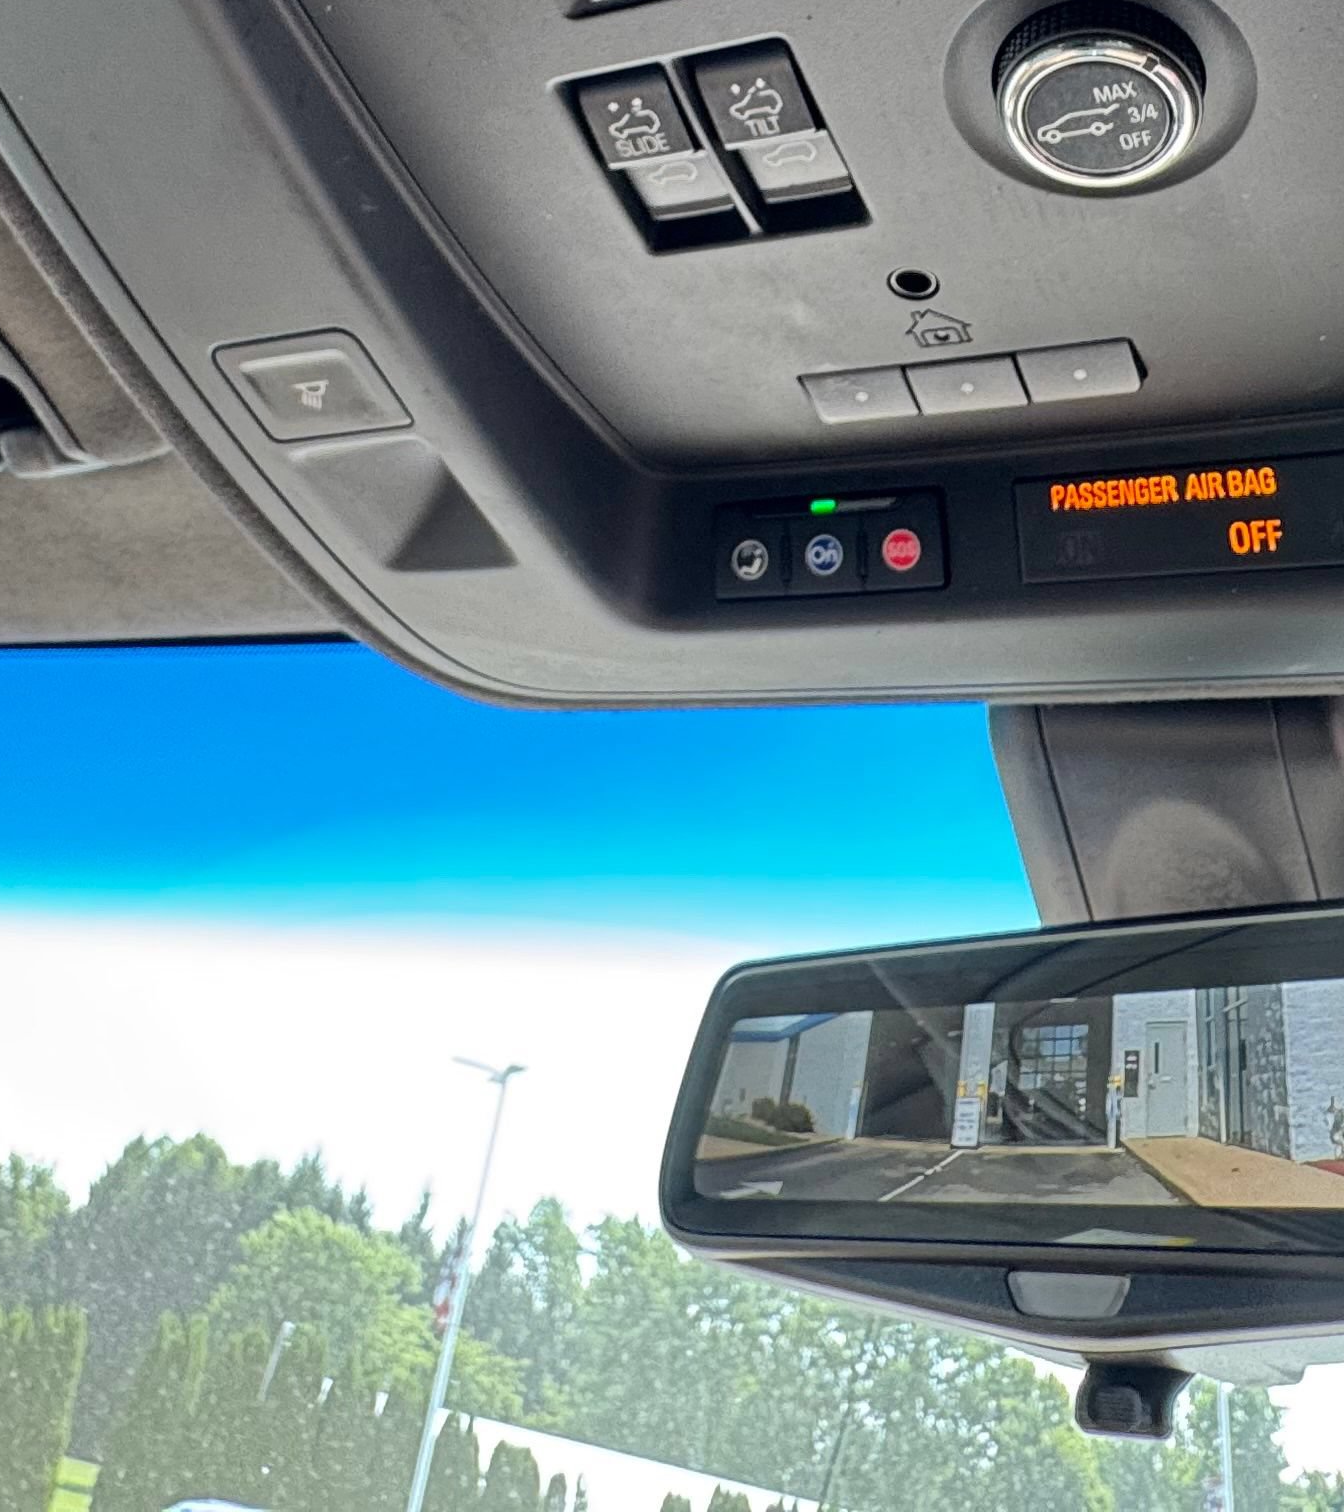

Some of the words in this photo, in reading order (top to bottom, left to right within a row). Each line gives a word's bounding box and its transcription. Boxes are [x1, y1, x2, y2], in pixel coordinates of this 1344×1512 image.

[1092, 81, 1138, 104] MAX
[1127, 103, 1159, 124] 3/4
[744, 115, 780, 137] TILT
[615, 133, 671, 159] SLIDE
[1119, 130, 1152, 151] OFF
[1050, 474, 1179, 512] PASSENGER
[1185, 471, 1225, 501] AIR
[1226, 466, 1278, 499] BAG
[1228, 518, 1283, 555] OFF
